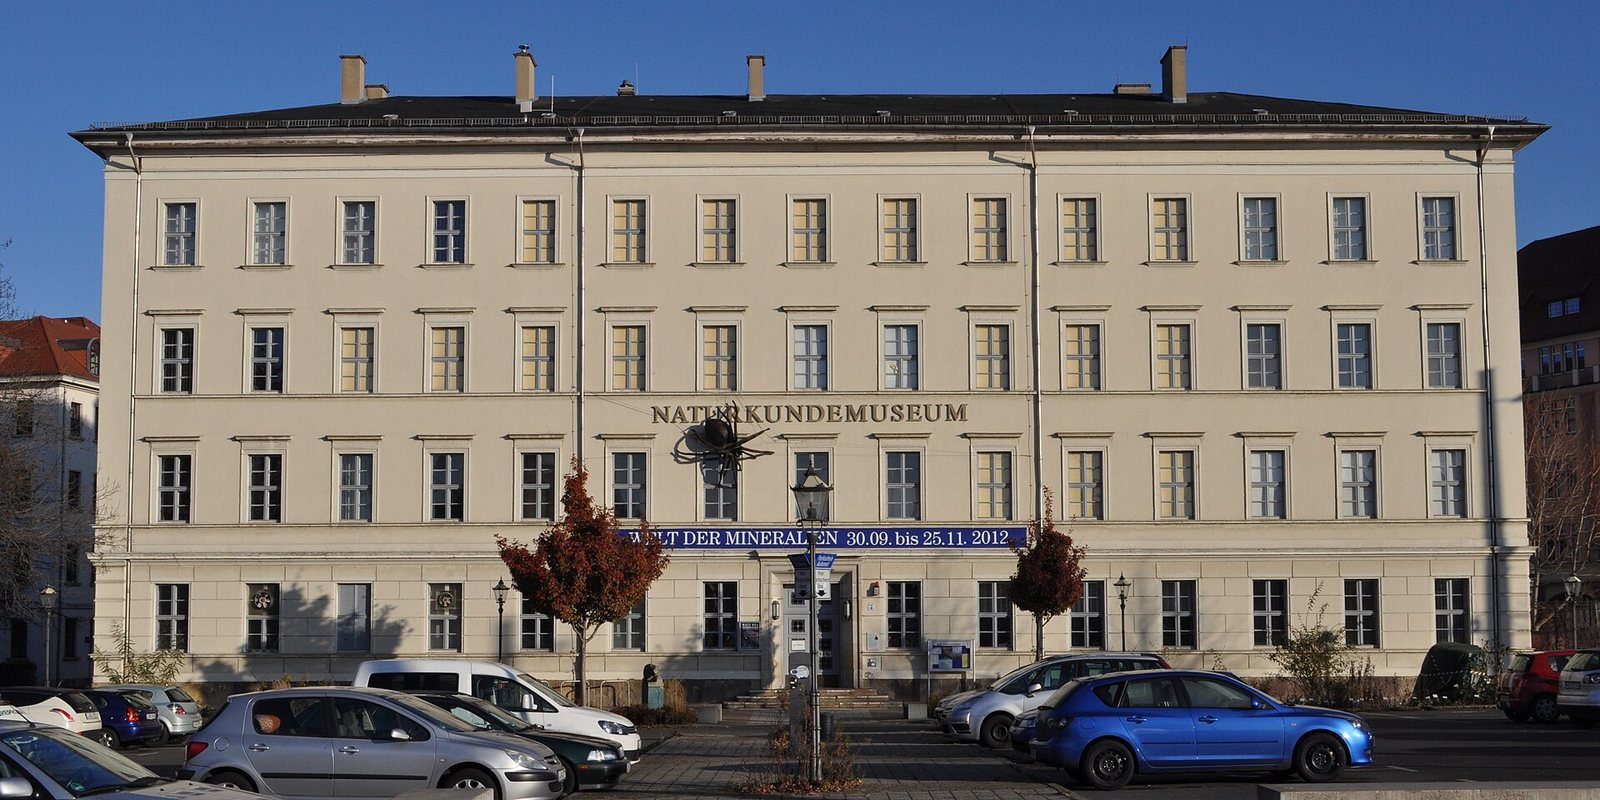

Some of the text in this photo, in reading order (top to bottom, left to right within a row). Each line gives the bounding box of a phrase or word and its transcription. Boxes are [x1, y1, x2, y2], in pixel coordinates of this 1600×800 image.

[683, 531, 721, 545] DER
[725, 530, 839, 546] MINERALEN
[846, 531, 892, 546] 30.09.
[894, 531, 919, 546] bis
[923, 531, 968, 546] 25.11.
[972, 530, 1009, 545] 2012
